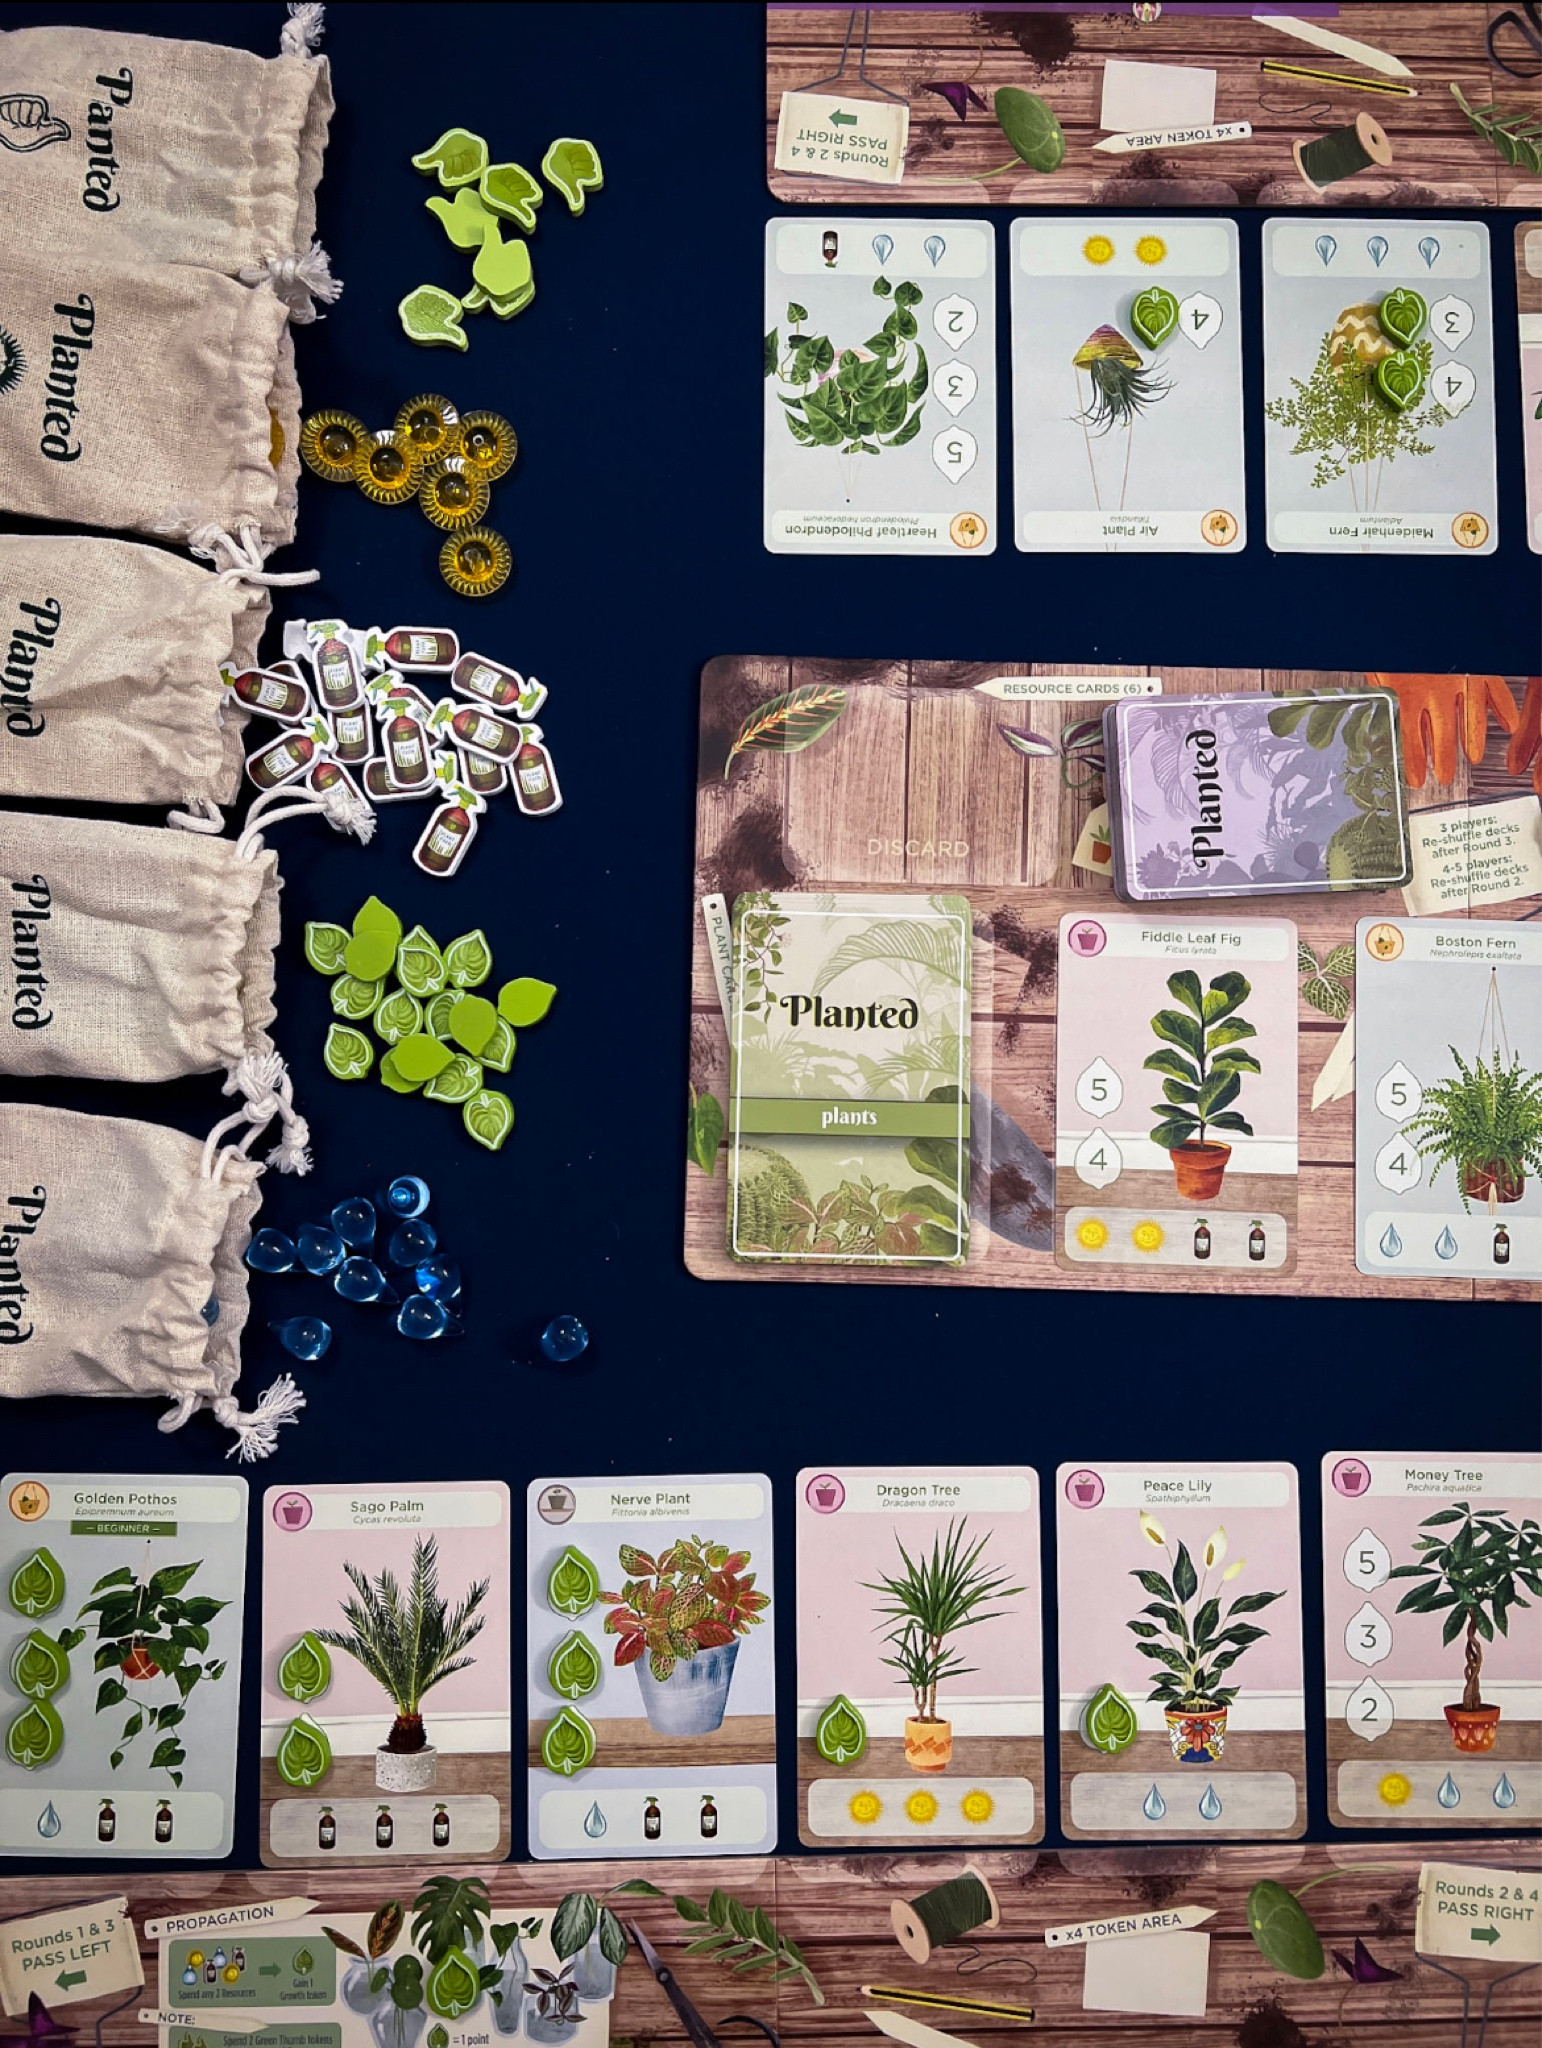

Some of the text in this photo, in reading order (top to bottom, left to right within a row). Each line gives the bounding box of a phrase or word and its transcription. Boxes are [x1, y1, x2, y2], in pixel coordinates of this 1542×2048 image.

[796, 128, 888, 150] PASS RIGHT
[1126, 127, 1232, 147] x4 TOKEN AREA
[791, 145, 889, 168] Rounds 2 & 4
[948, 311, 963, 333] 2
[1191, 309, 1210, 330] 4
[1445, 312, 1460, 333] 3
[40, 293, 96, 463] Planted
[948, 376, 963, 397] 3
[1444, 376, 1463, 397] 4
[947, 442, 962, 463] 5
[785, 525, 937, 538] Heartleaf Philodendron
[1102, 526, 1159, 536] Air Plant
[1329, 526, 1434, 538] Maidenhair Fern
[1003, 684, 1141, 695] RESOURCE CARDS (6)
[1185, 729, 1225, 868] Planted
[1440, 816, 1498, 833] 3 players:
[1422, 823, 1520, 848] Re-shuffle decks
[868, 839, 970, 858] DISCARD
[1432, 836, 1516, 859] after Round 3.
[1443, 854, 1513, 874] 4-5 players:
[1431, 864, 1529, 889] Re-shuffle decks
[1441, 877, 1524, 899] after Round 2.
[712, 916, 731, 960] PLANT
[1141, 931, 1241, 946] Fiddle Leaf Fig
[1435, 935, 1516, 948] Boston Fern
[11, 874, 54, 1029] Planted
[779, 995, 919, 1031] Planted
[1091, 1078, 1107, 1101] 5
[1390, 1083, 1407, 1106] 5
[822, 1106, 878, 1129] plants
[1088, 1147, 1107, 1171] 4
[1389, 1152, 1408, 1175] 4
[0, 1185, 47, 1344] Planted
[1144, 1480, 1212, 1492] Peace Lily
[1405, 1469, 1483, 1482] Money Tree
[74, 1492, 177, 1505] Golden Pothos
[611, 1493, 691, 1505] Nerve Plant
[877, 1484, 960, 1497] Dragon Tree
[351, 1500, 424, 1514] Sago Palm
[882, 1499, 955, 1507] Dracaena draco
[97, 1524, 150, 1533] BEGINNER
[1359, 1550, 1376, 1575] 5
[1360, 1624, 1377, 1648] 3
[1360, 1698, 1378, 1722] 2
[1435, 1880, 1539, 1902] Rounds 2 & 4
[167, 1906, 274, 1932] PROPAGATION
[1438, 1901, 1535, 1921] PASS RIGHT
[12, 1919, 115, 1953] Rounds 1 & 3
[1065, 1914, 1182, 1941] x4 TOKEN AREA
[22, 1940, 111, 1971] PASS LEFT
[293, 1978, 309, 1988] Gain
[178, 1990, 200, 2000] Spend
[279, 1991, 305, 2000] Growth
[158, 2012, 196, 2025] NOTE:
[223, 2036, 247, 2046] Spend
[255, 2036, 277, 2045] Green
[279, 2034, 306, 2045] Thumb
[467, 2033, 490, 2045] point
